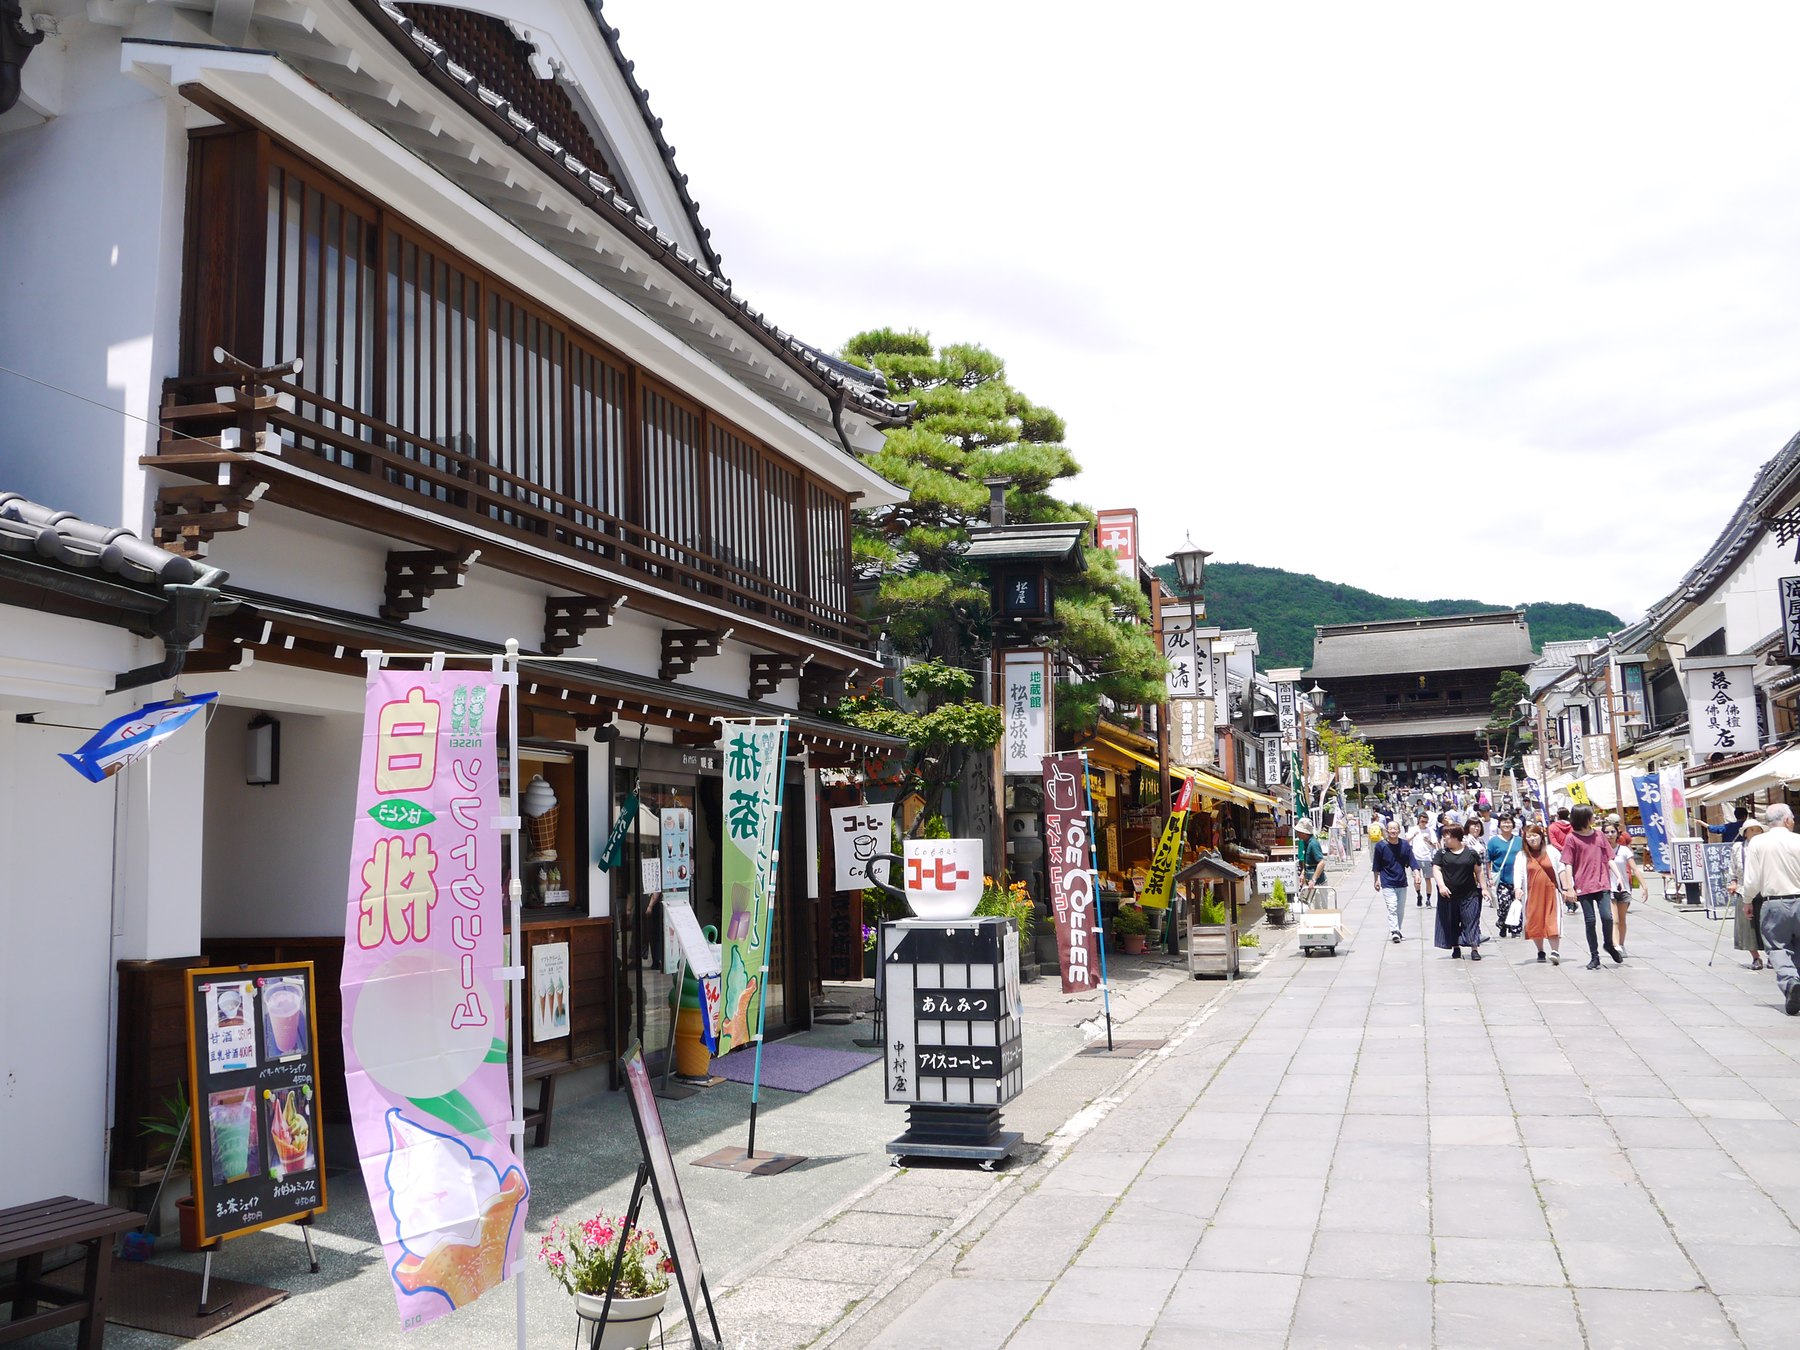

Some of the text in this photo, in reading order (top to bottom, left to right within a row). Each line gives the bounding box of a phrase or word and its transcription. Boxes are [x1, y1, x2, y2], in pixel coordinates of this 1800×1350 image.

[1030, 671, 1041, 708] 地蔵館
[1710, 671, 1734, 705] 落合
[1714, 728, 1735, 748] 店
[843, 815, 883, 832] コーヒー
[1640, 782, 1671, 865] おやき
[908, 858, 969, 891] コーヒー
[922, 997, 988, 1013] あんみつ
[210, 1030, 232, 1044] 甘酒
[892, 1040, 907, 1092] 中村屋
[919, 1053, 993, 1070] アイスコーヒー
